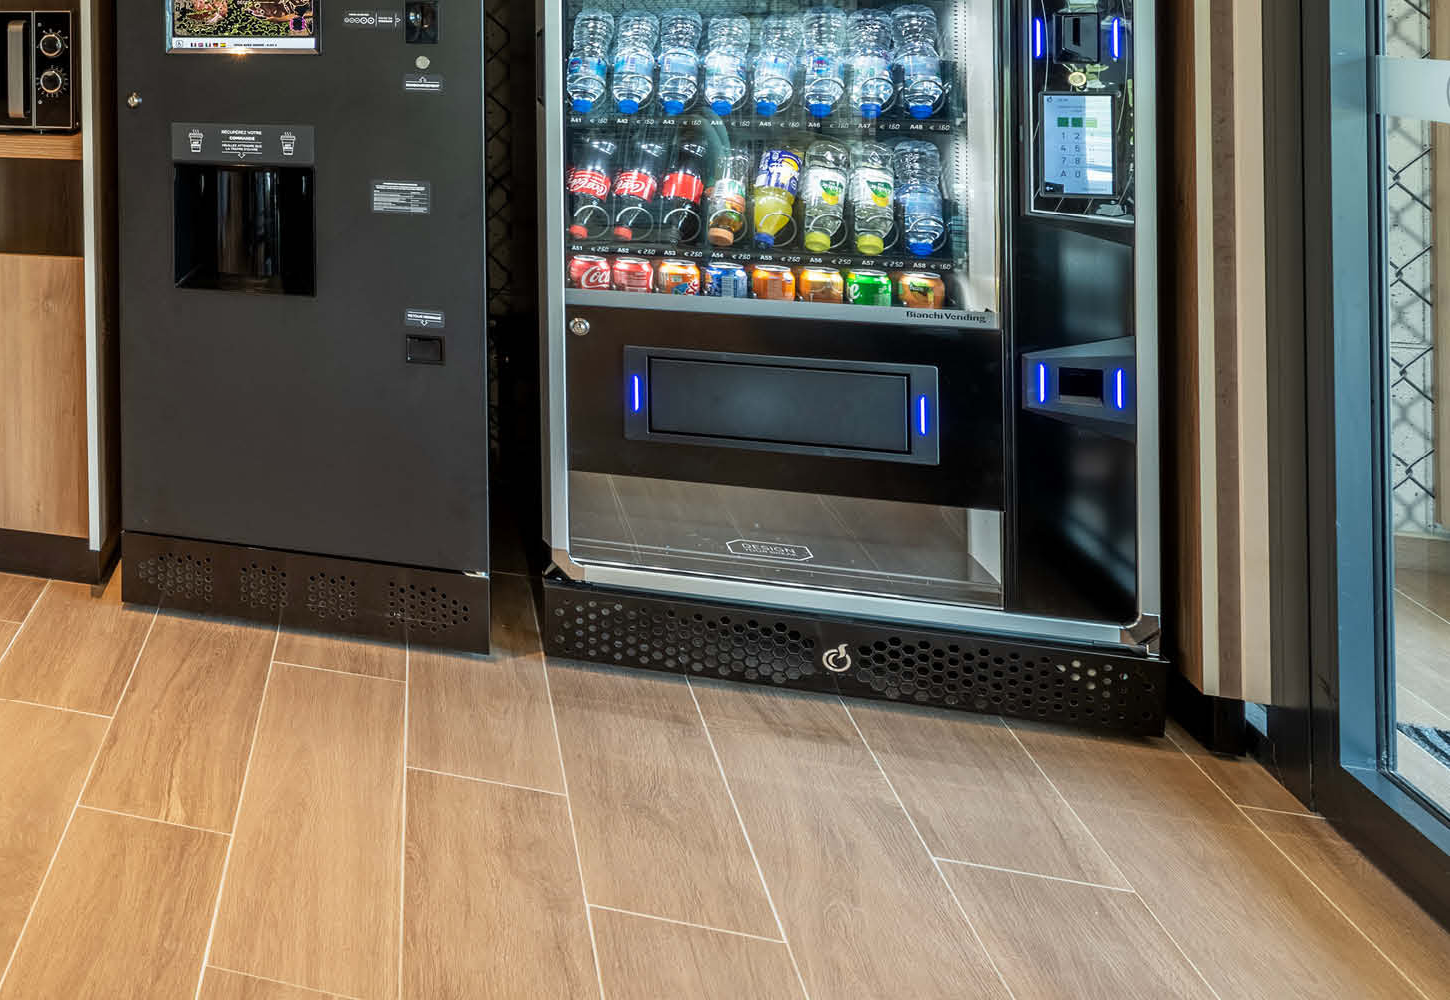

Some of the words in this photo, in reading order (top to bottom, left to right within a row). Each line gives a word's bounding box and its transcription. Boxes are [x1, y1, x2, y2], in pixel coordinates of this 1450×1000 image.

[1061, 132, 1066, 140] 1
[1074, 132, 1080, 140] 2
[1060, 144, 1066, 152] 4
[1074, 144, 1080, 152] 5
[1061, 157, 1067, 165] 7
[1075, 157, 1080, 165] 8
[906, 310, 943, 320] Bianchi
[944, 313, 986, 323] Vending
